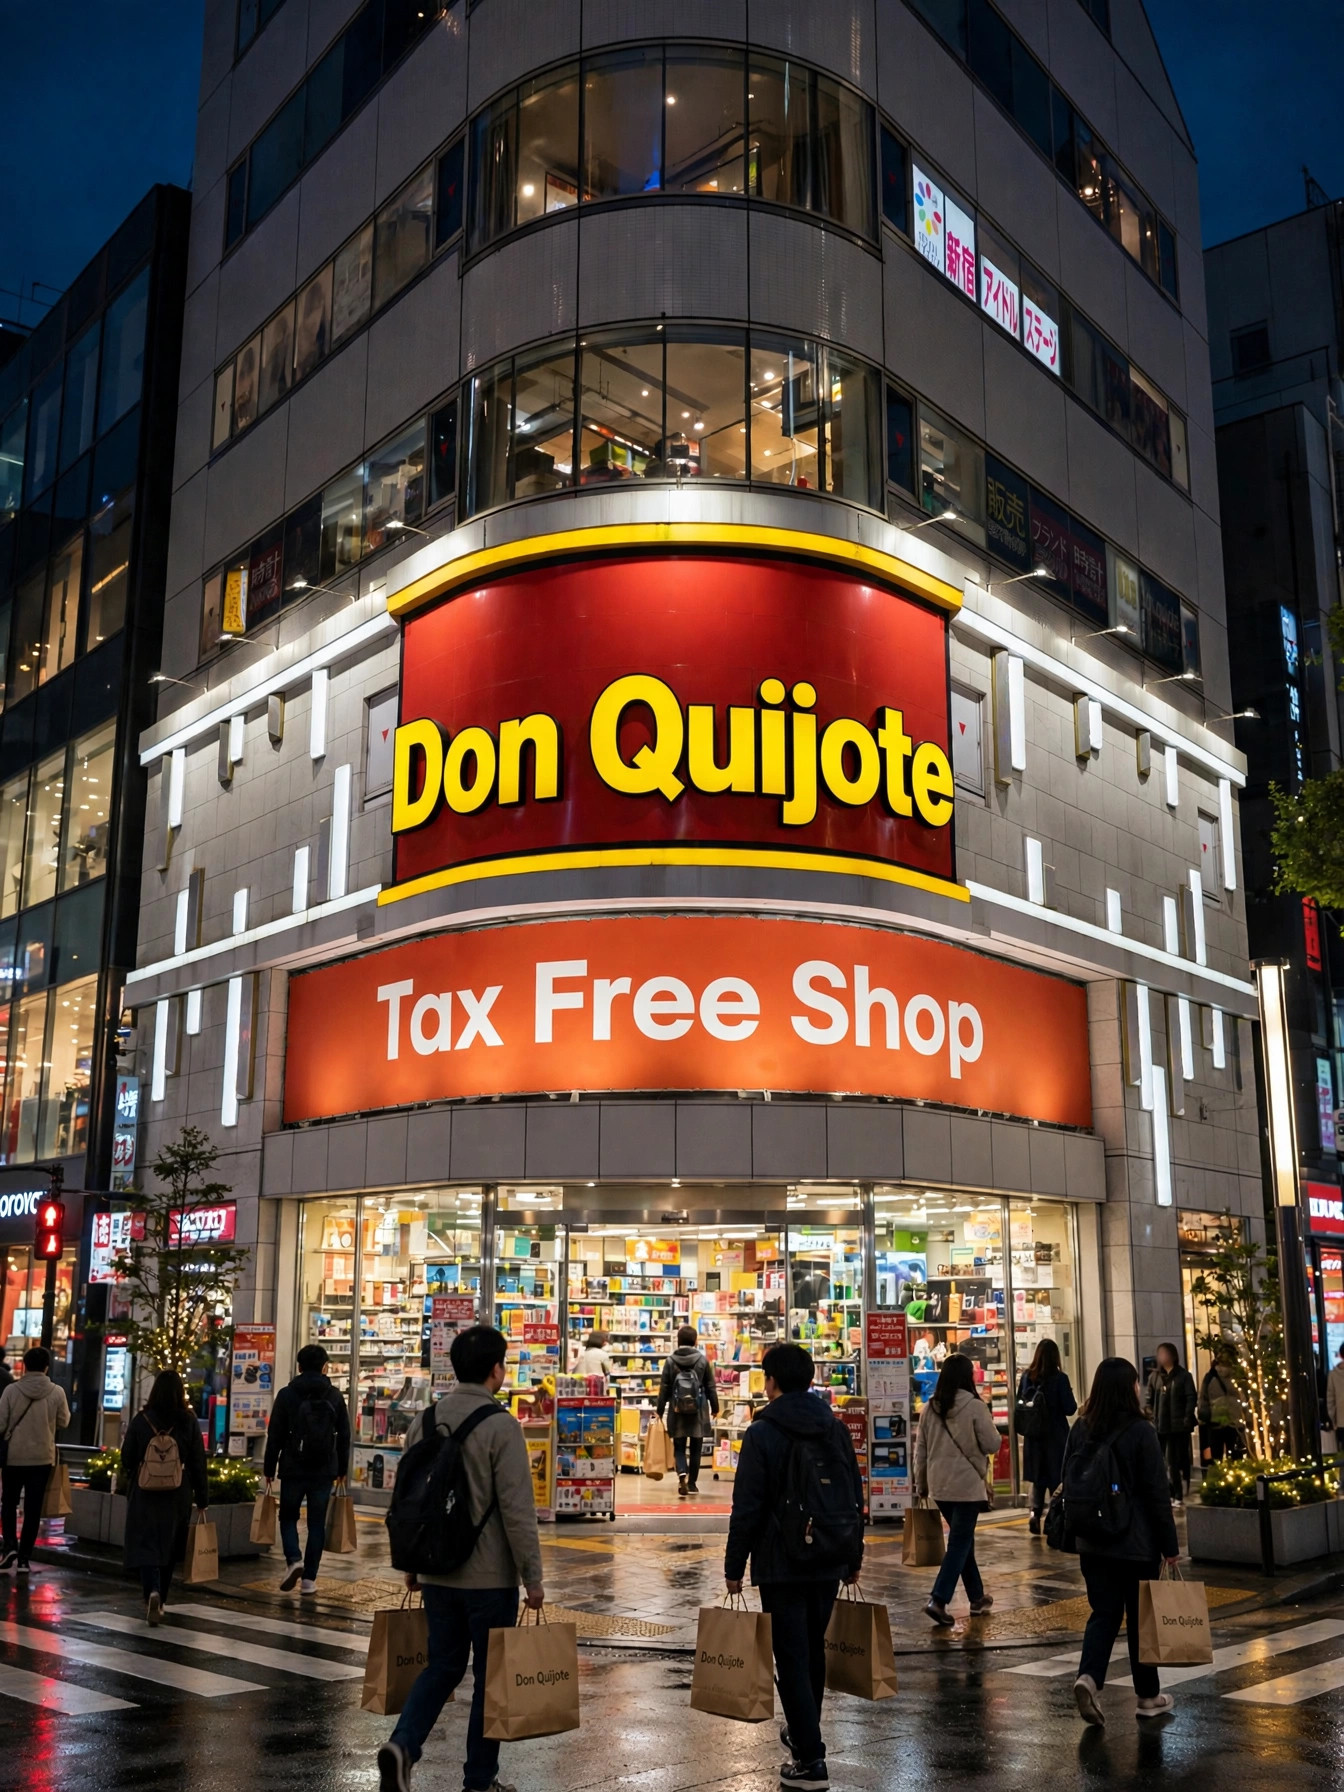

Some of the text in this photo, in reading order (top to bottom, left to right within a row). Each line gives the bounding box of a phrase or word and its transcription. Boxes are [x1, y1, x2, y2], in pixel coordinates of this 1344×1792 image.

[946, 231, 975, 297] 新宿
[983, 267, 1018, 334] アイドル
[1025, 308, 1057, 366] ステージ
[987, 475, 1026, 538] 販売
[391, 673, 955, 834] Don Quijote
[377, 959, 984, 1080] Tax Free Shop
[1161, 1615, 1178, 1626] Don
[396, 1655, 415, 1667] Don
[515, 1669, 570, 1687] Don Quijote
[700, 1650, 745, 1670] Don Quijote
